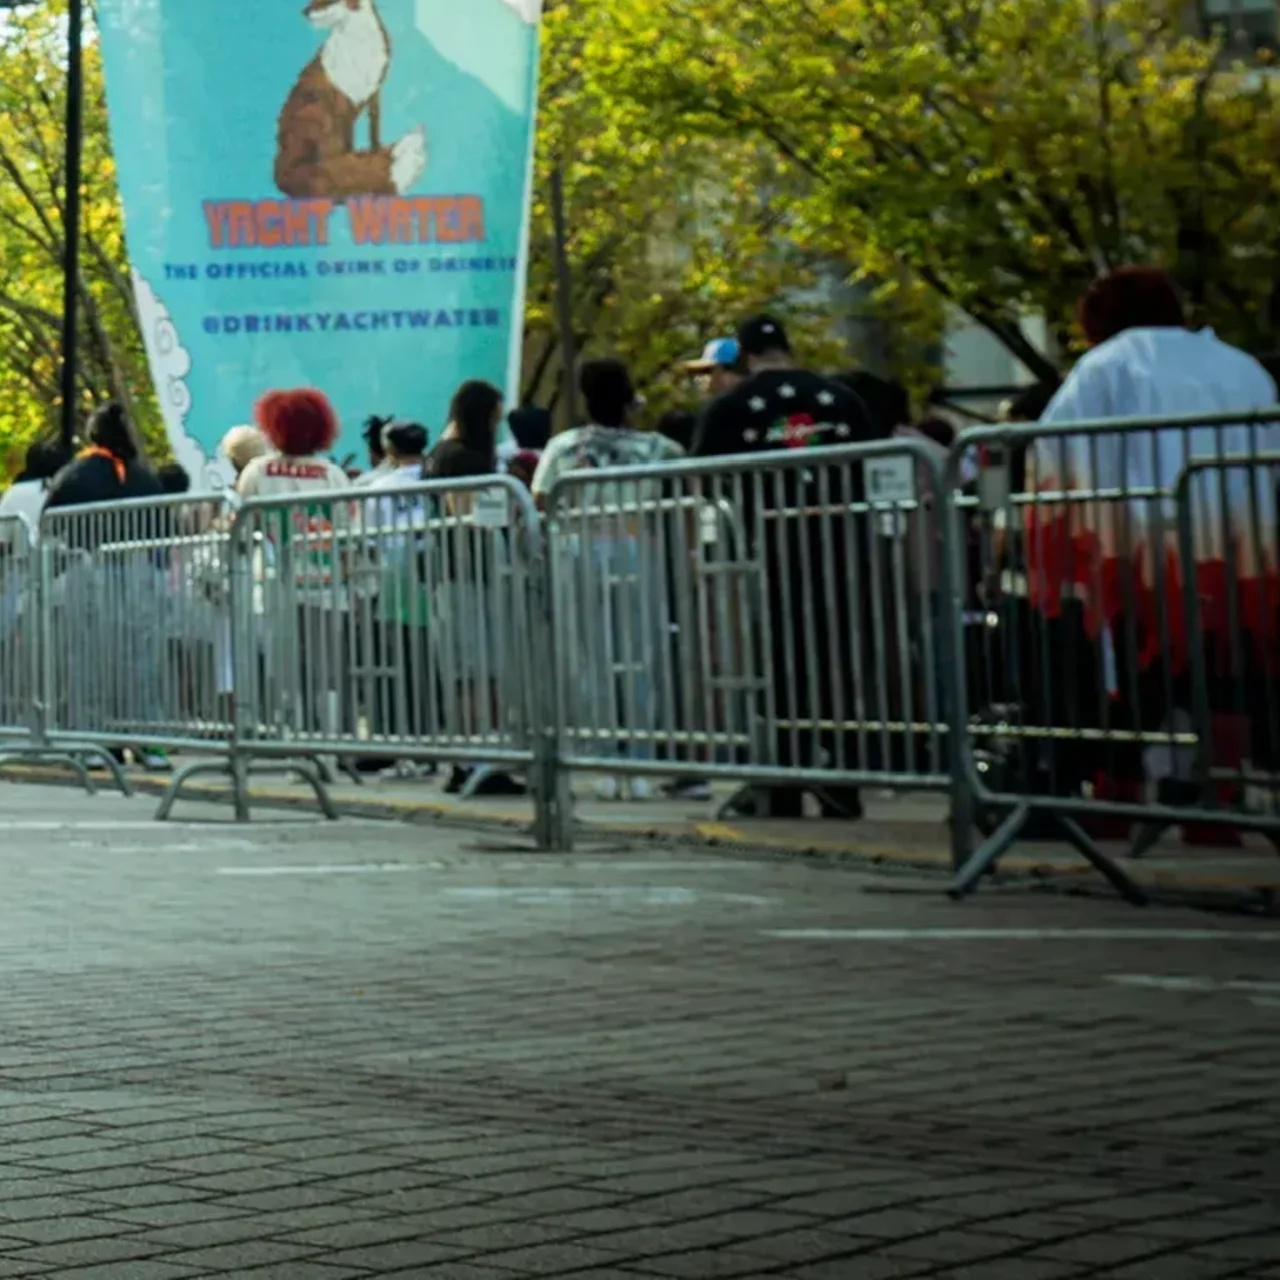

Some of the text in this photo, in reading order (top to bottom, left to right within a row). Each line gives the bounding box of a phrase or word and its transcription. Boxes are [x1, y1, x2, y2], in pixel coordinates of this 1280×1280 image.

[202, 193, 486, 250] YACHT WATER
[206, 262, 308, 279] OFFICIAL
[316, 259, 385, 277] DRINK
[393, 258, 420, 273] OF
[203, 308, 500, 334] @DRINKYACHTWATER
